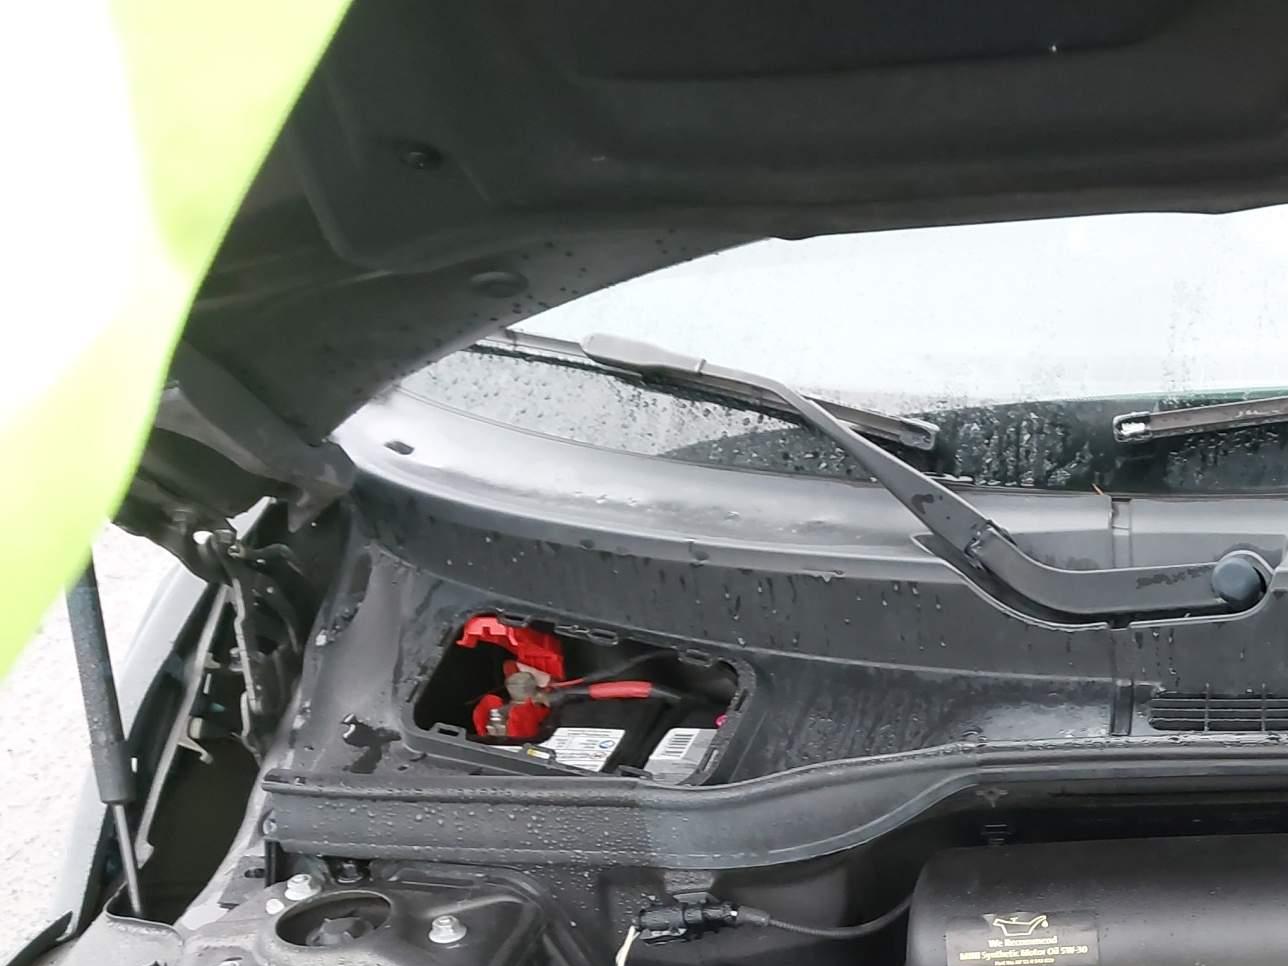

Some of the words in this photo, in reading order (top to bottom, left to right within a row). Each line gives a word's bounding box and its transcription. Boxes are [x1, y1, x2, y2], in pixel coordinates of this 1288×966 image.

[1003, 936, 1058, 947] Recommend
[981, 949, 1019, 961] Synthetic
[1020, 949, 1046, 957] Motor
[1060, 945, 1088, 955] 5W-30
